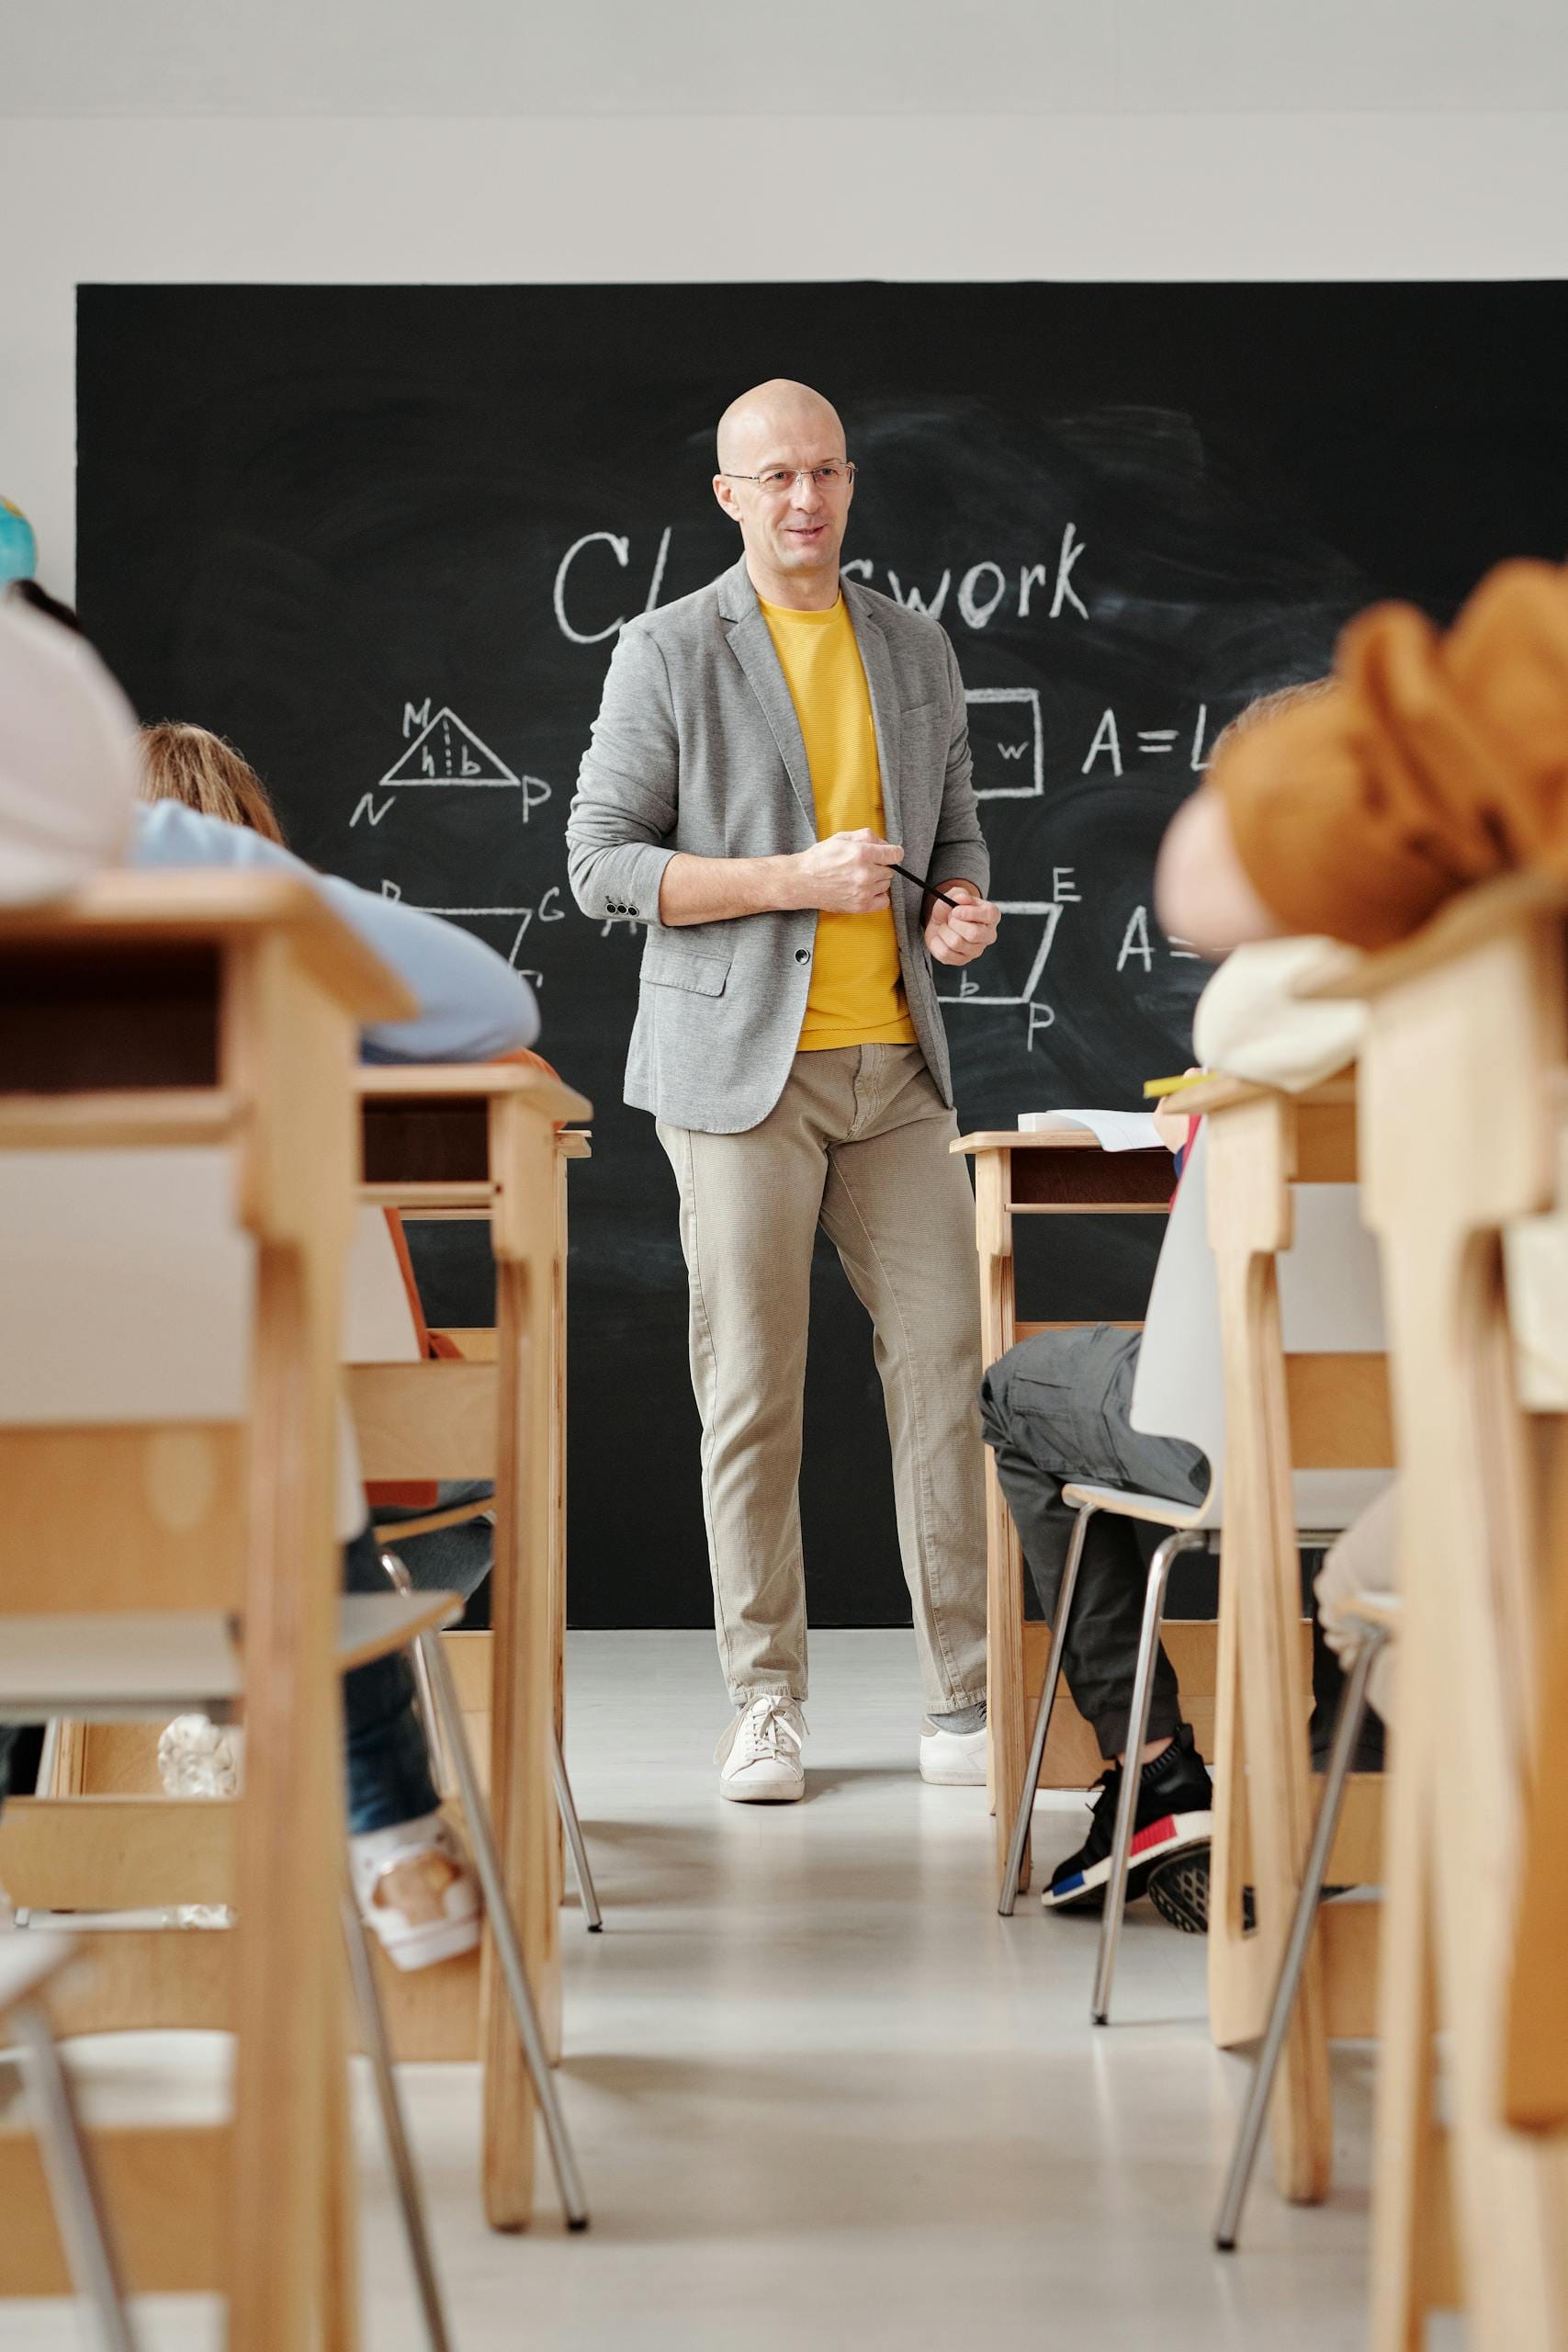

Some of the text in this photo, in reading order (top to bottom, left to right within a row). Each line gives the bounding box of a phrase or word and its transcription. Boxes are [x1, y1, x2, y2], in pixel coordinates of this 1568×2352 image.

[553, 522, 1089, 644] Clwork
[402, 697, 432, 738] M
[460, 745, 481, 777] b
[348, 792, 397, 828] N
[523, 775, 552, 824] P
[1052, 866, 1082, 903] E
[1027, 1002, 1056, 1053] P
